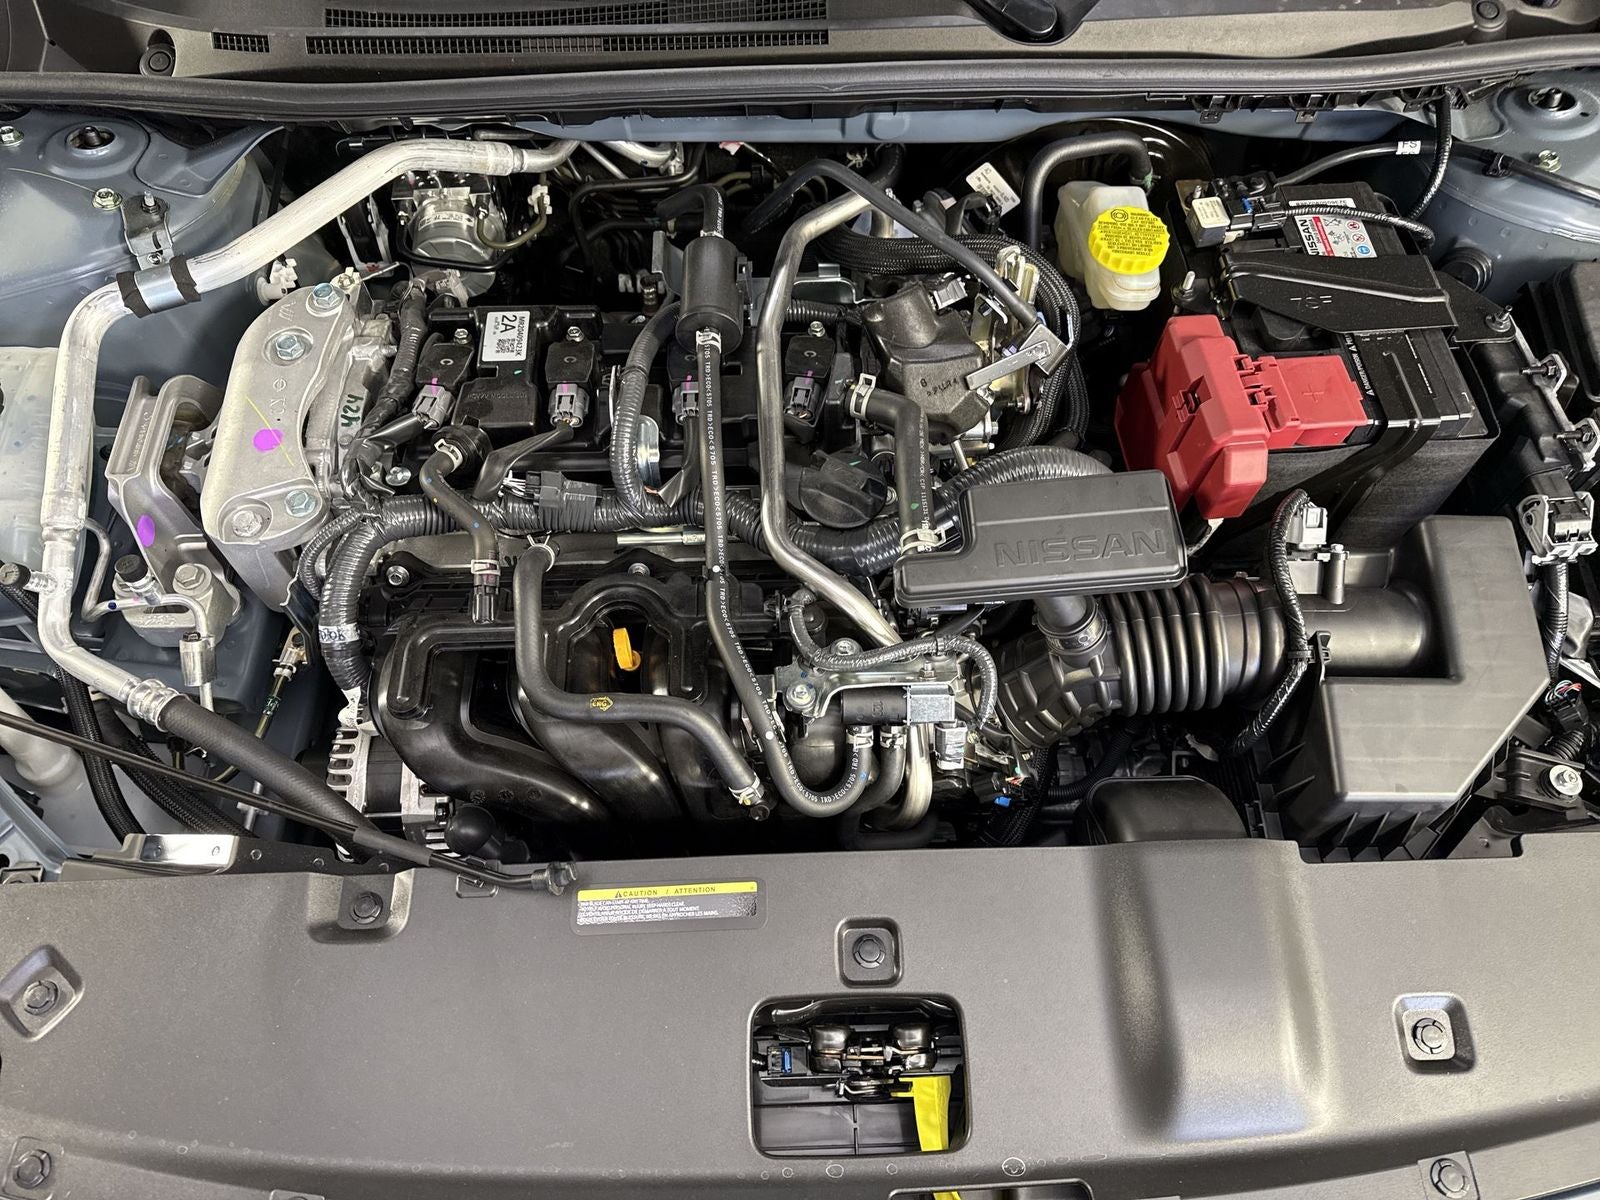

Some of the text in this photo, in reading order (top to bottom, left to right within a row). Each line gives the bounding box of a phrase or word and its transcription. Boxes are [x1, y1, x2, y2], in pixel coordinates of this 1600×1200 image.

[500, 314, 518, 334] 2A
[994, 529, 1167, 568] NISSAN
[623, 889, 658, 897] CAUTION
[674, 886, 716, 895] ATTENTION
